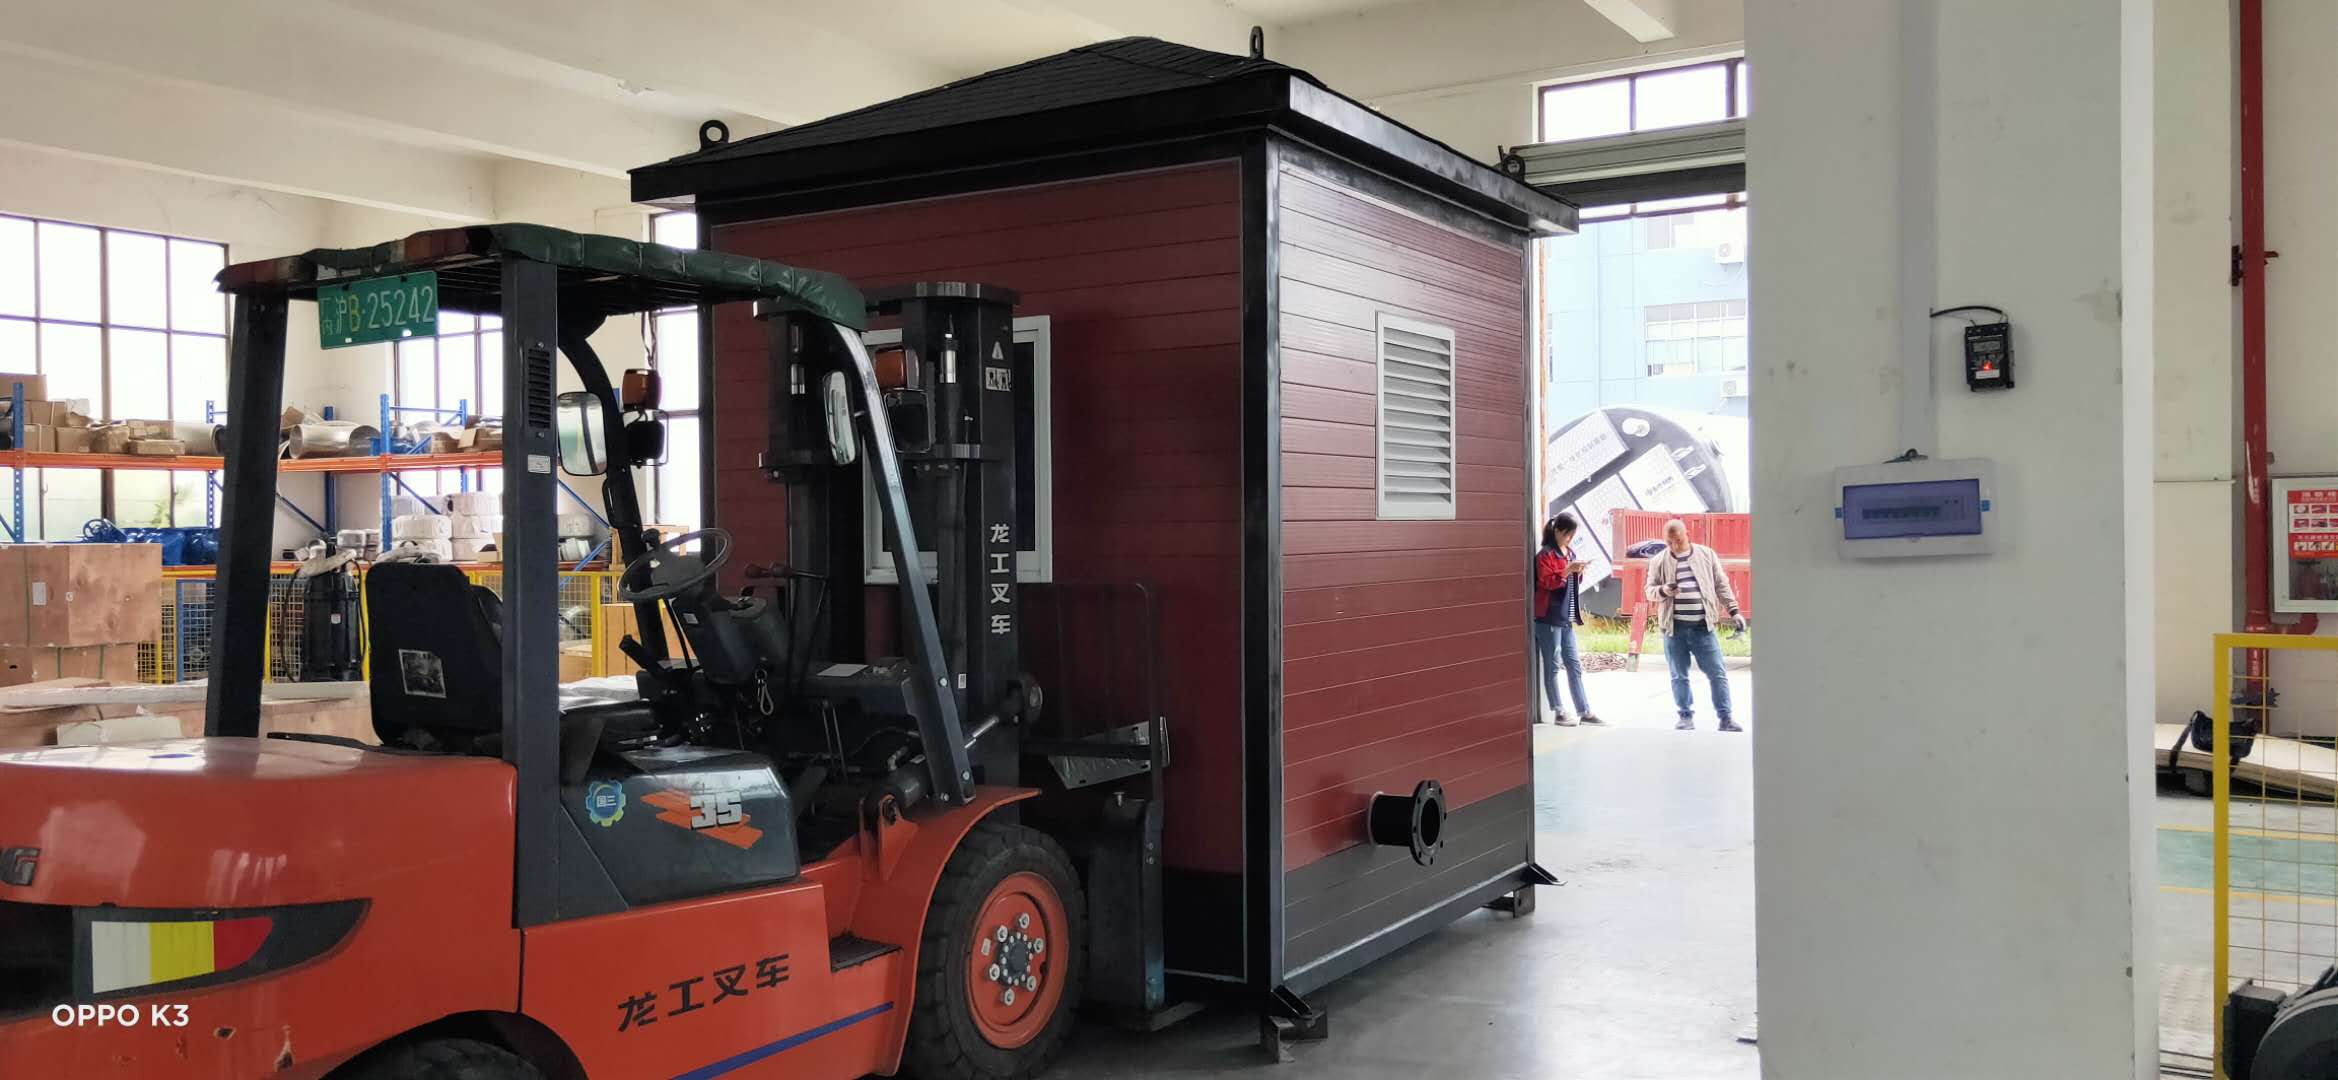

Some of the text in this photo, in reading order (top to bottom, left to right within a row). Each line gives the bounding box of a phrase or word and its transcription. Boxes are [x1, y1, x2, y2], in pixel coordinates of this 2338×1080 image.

[990, 523, 1011, 634] 龙工叉车
[690, 791, 743, 830] 35
[0, 847, 41, 886] G
[617, 953, 790, 1033] 龙工叉车
